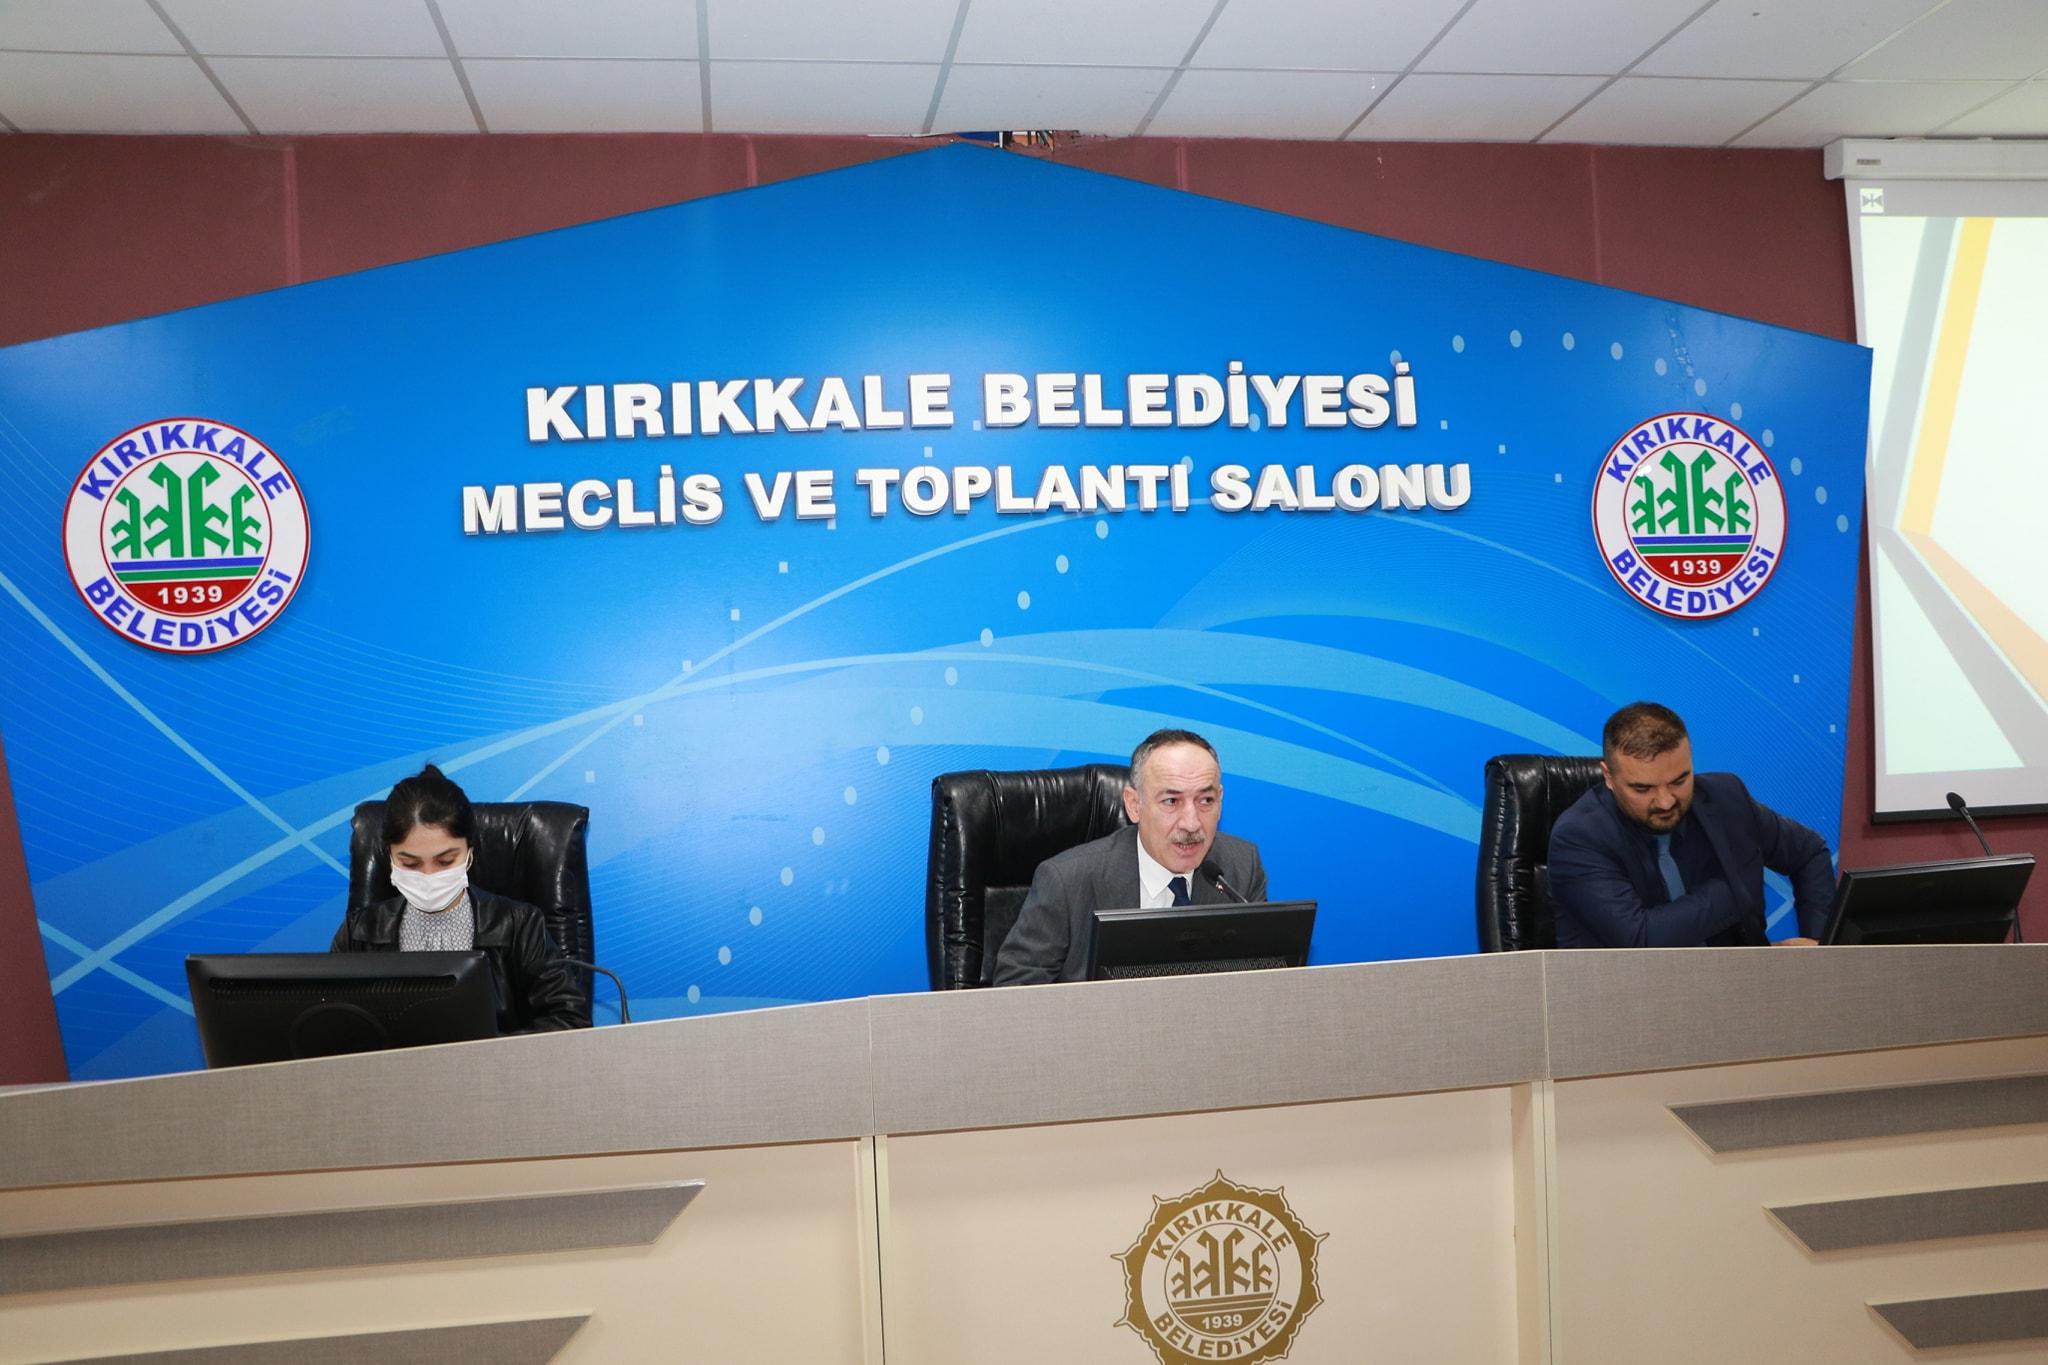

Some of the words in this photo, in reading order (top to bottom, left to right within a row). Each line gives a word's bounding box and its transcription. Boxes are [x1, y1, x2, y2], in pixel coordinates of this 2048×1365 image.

[527, 373, 953, 442] KIRIKKALE
[80, 424, 291, 501] KIRIKKALE
[1606, 417, 1771, 486] KIRIKKALE
[744, 470, 836, 520] VE
[856, 464, 1189, 517] TOPLANTI
[1210, 463, 1472, 512] SALONU
[158, 586, 223, 605] 1939
[1670, 559, 1721, 575] 1939
[1151, 1202, 1292, 1260] KIRIKKALE
[1202, 1314, 1243, 1329] 1939
